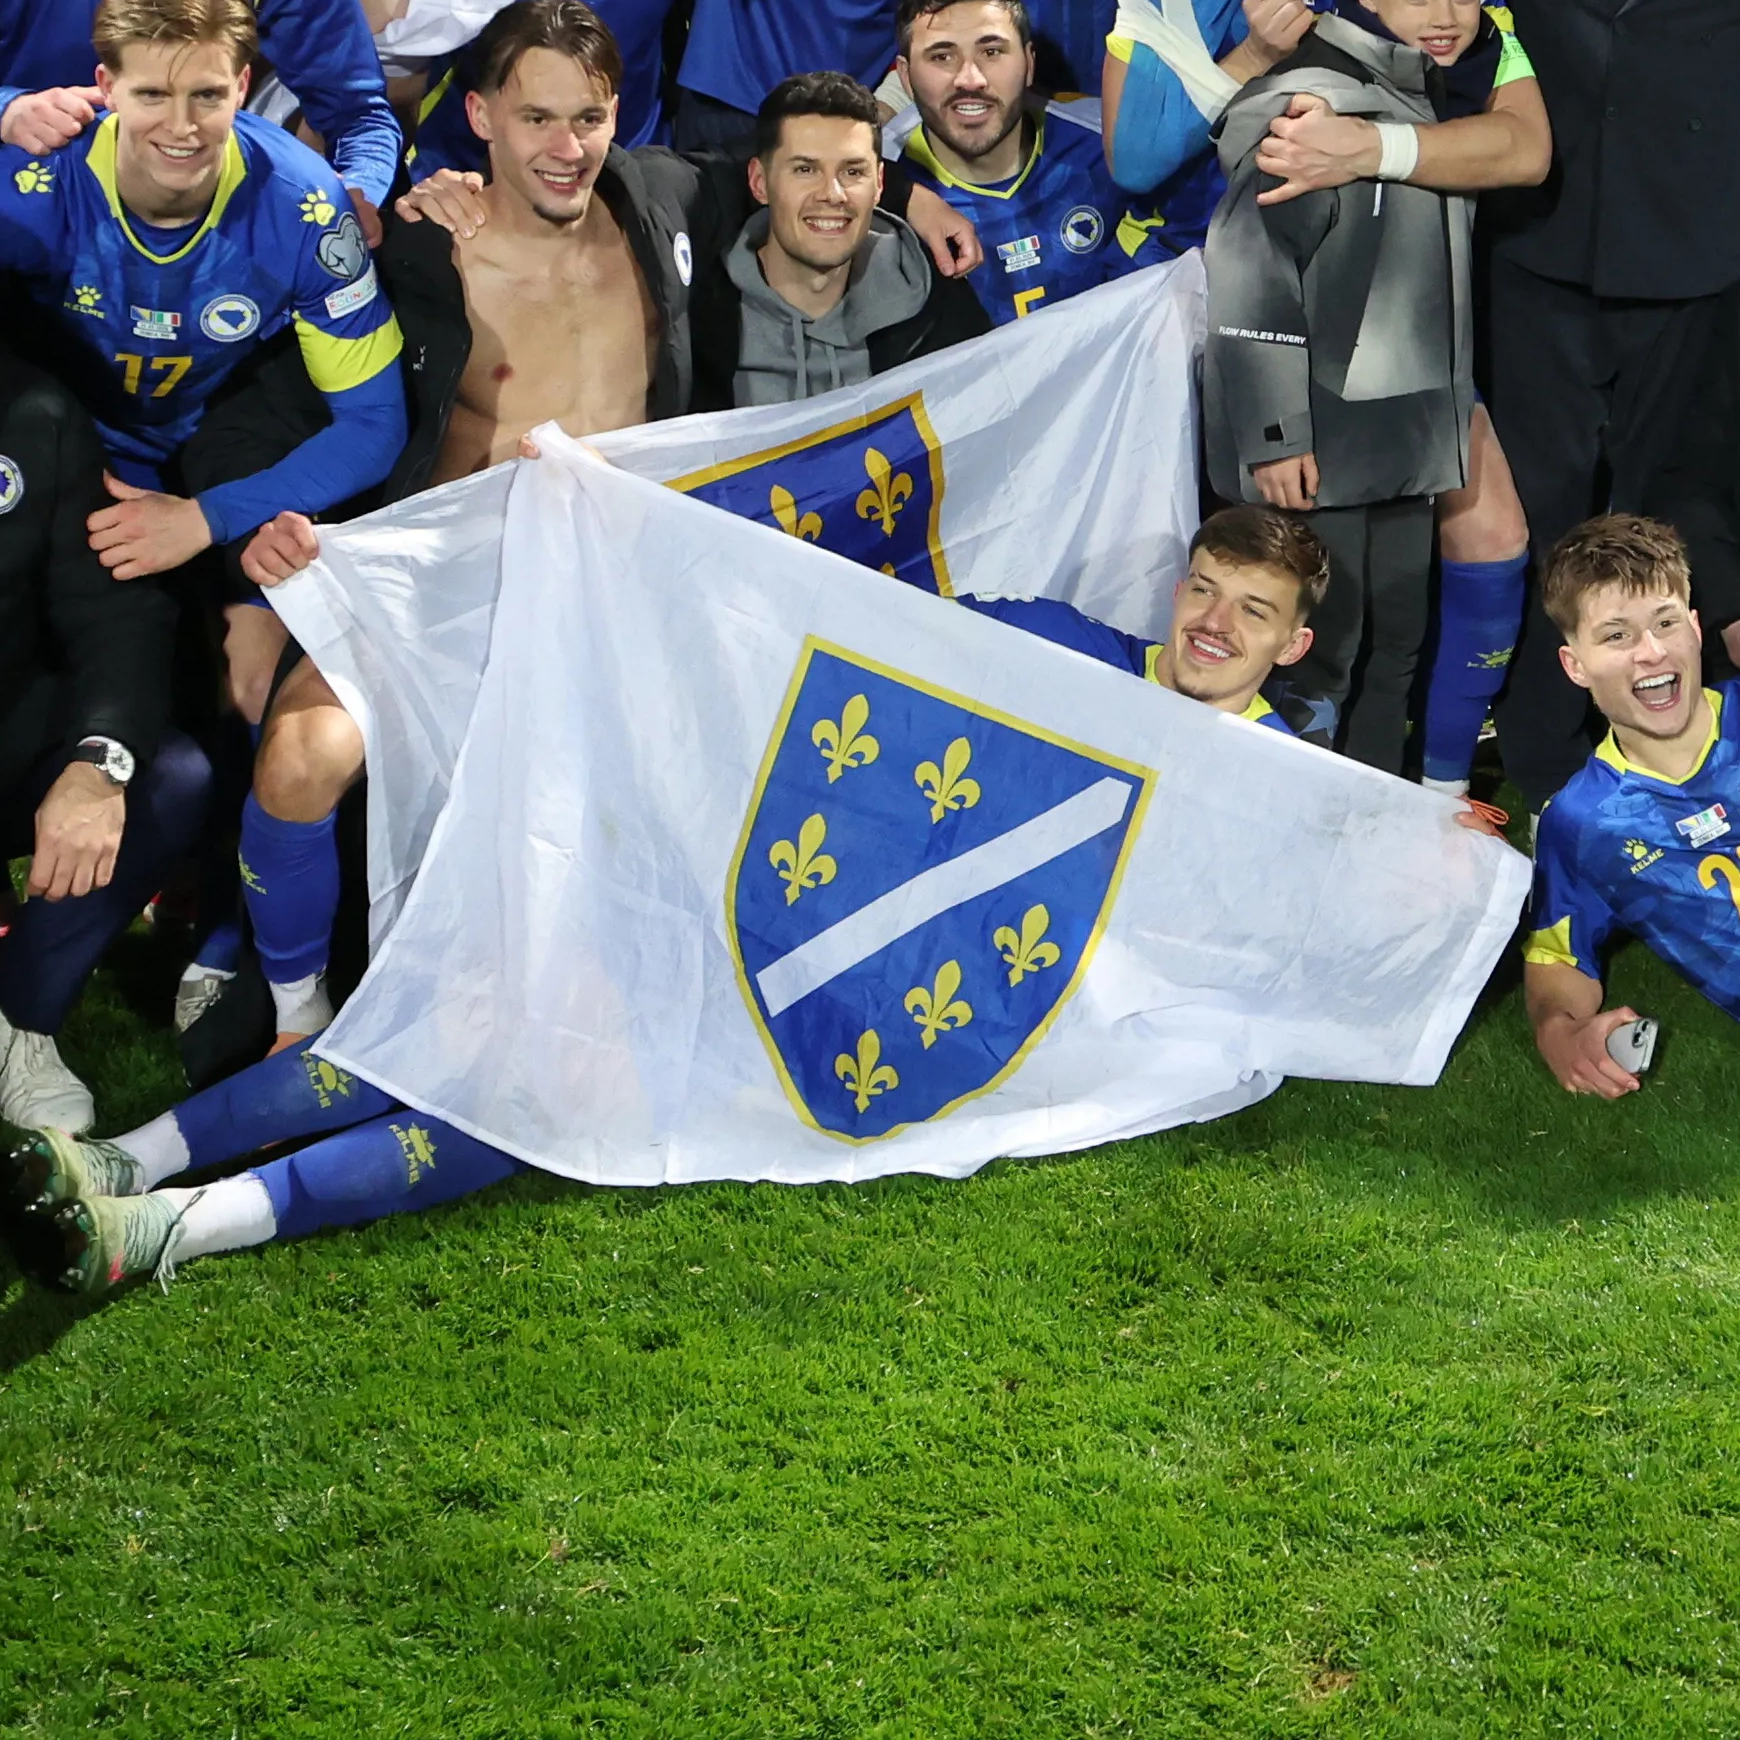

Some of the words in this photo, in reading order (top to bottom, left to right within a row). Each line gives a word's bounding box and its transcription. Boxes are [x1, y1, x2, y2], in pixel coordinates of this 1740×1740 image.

[1219, 325, 1240, 337] FLOW
[1240, 329, 1274, 340] RULES
[1275, 333, 1306, 345] EVERY
[115, 354, 194, 398] 17
[1629, 848, 1665, 875] KELME
[301, 1048, 331, 1109] KELME
[389, 1123, 420, 1184] KELME
